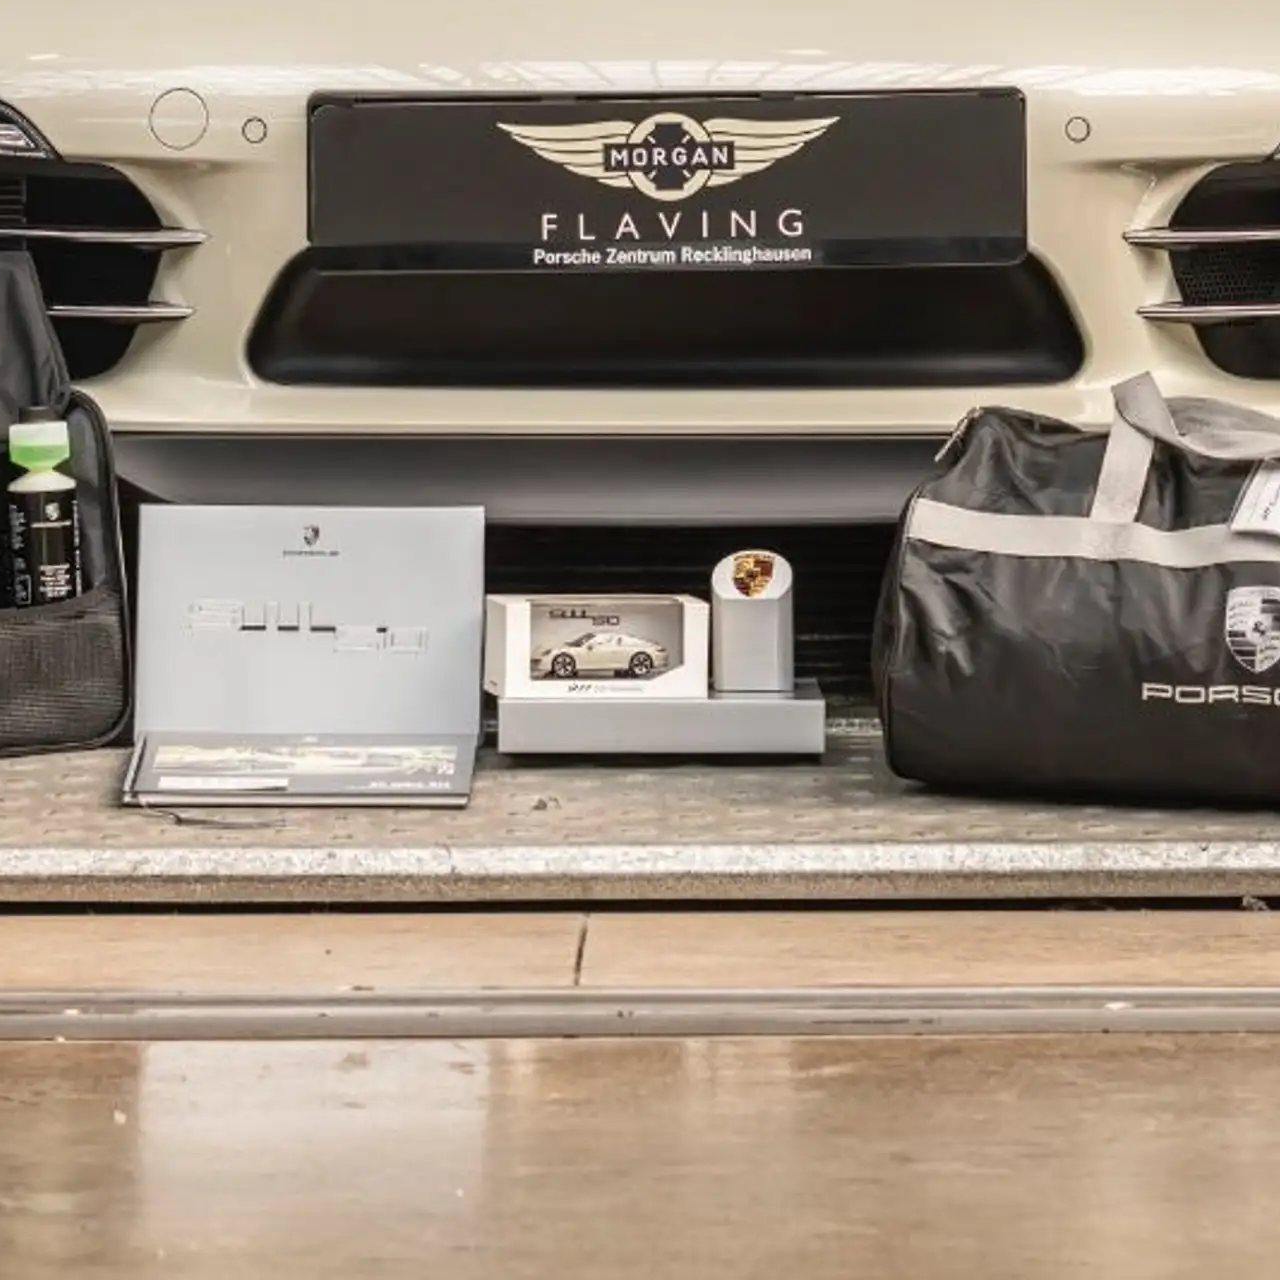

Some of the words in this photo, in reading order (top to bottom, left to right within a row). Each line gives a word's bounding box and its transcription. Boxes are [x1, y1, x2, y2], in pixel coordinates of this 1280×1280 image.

[609, 147, 730, 167] MORGAN
[540, 208, 804, 240] FLAVING
[533, 248, 601, 265] Porsche
[606, 247, 676, 264] Zentrum
[681, 245, 812, 266] Recklinghausen
